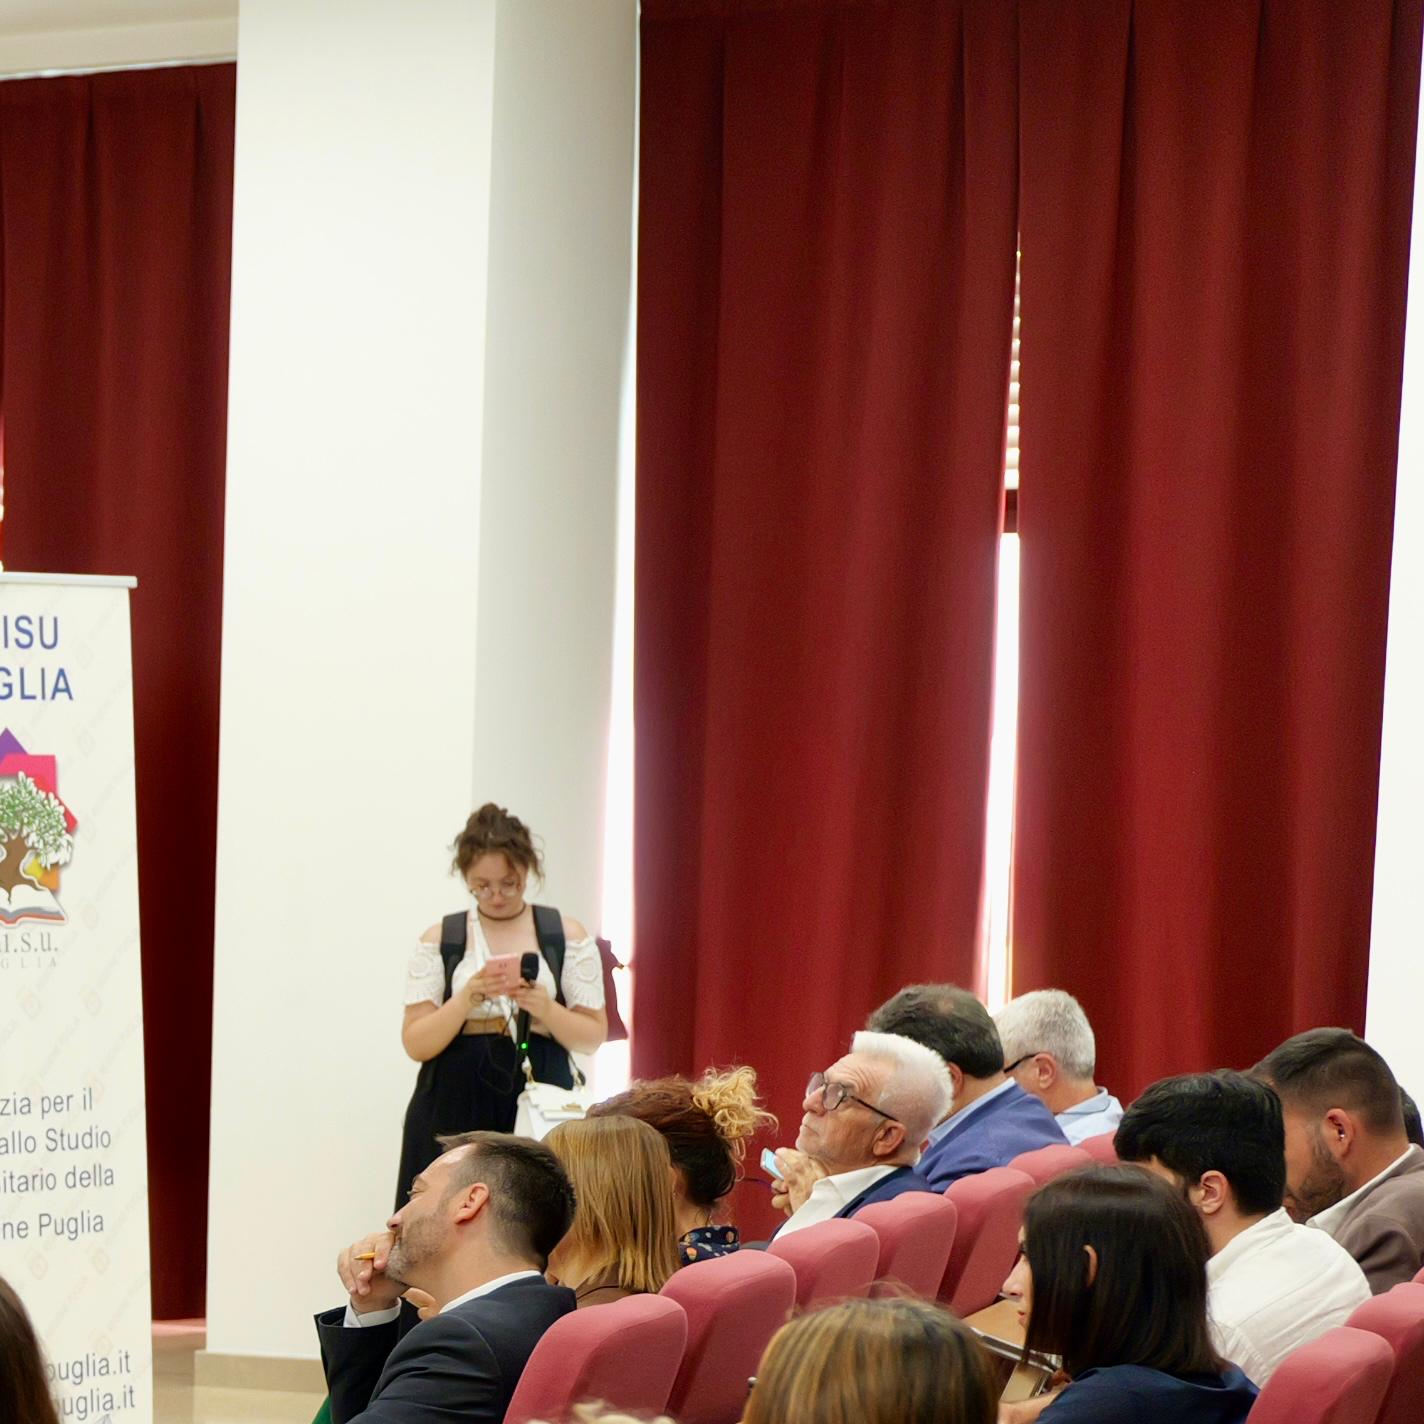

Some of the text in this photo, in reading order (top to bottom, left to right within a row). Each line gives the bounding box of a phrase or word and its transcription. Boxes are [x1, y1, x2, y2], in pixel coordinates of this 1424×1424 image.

[41, 1095, 74, 1119] per
[82, 1088, 93, 1111] il
[45, 1126, 112, 1152] Studio
[65, 1164, 115, 1189] della
[38, 1210, 104, 1243] Puglia
